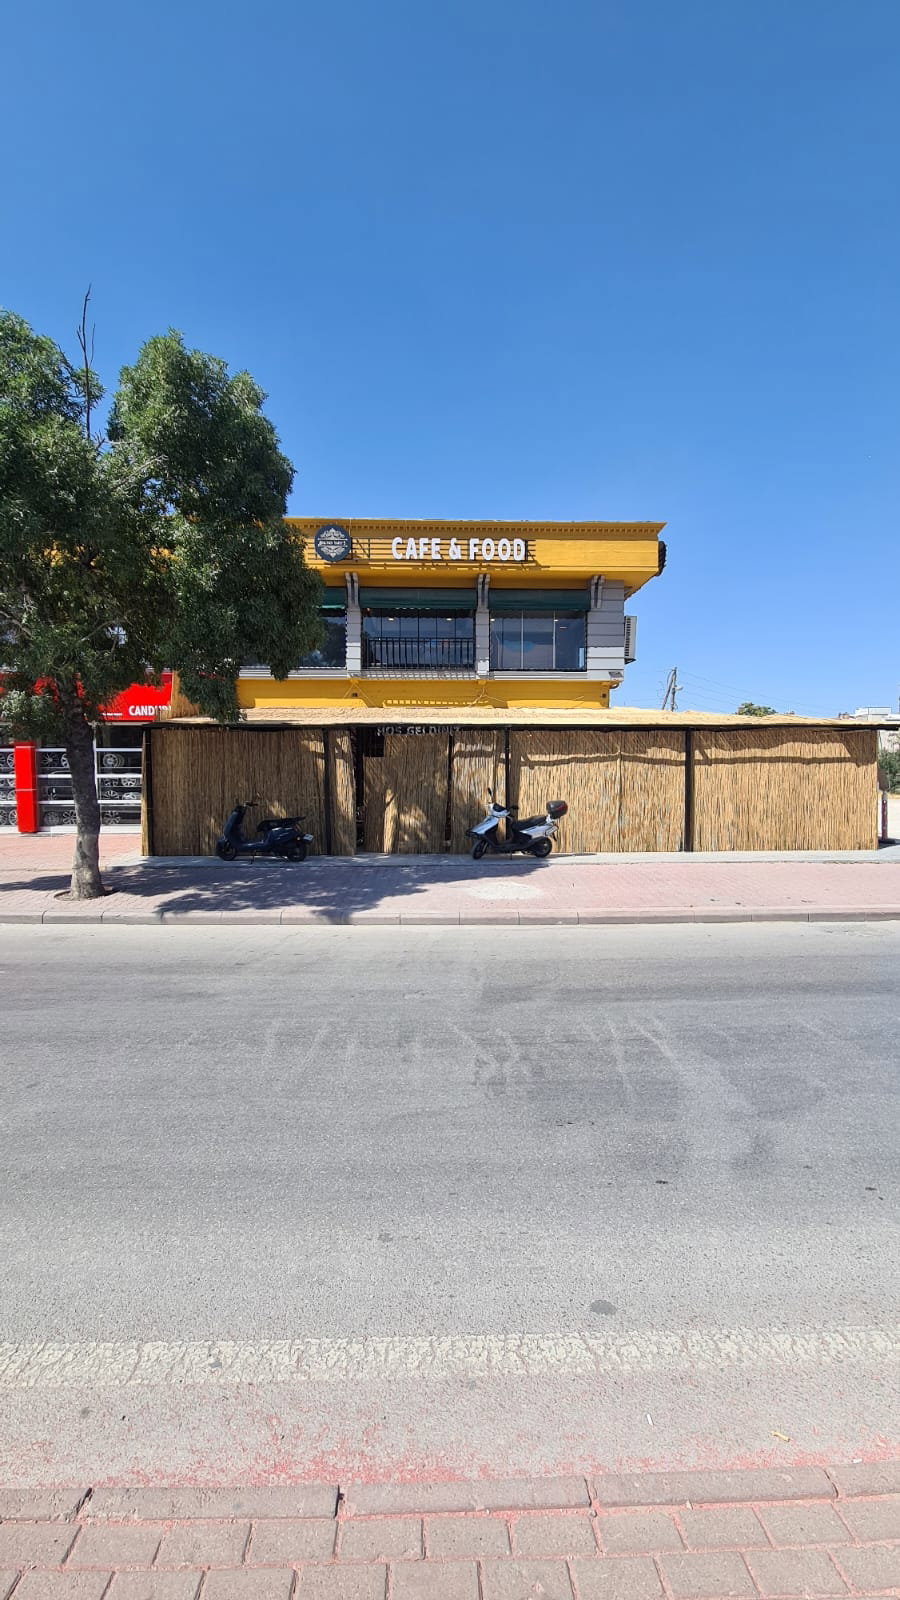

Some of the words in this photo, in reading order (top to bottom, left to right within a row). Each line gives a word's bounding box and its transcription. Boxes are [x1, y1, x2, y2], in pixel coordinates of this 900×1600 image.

[391, 536, 441, 560] CAFE
[448, 537, 461, 560] &
[469, 537, 527, 561] FOOD
[128, 704, 171, 716] CAND
